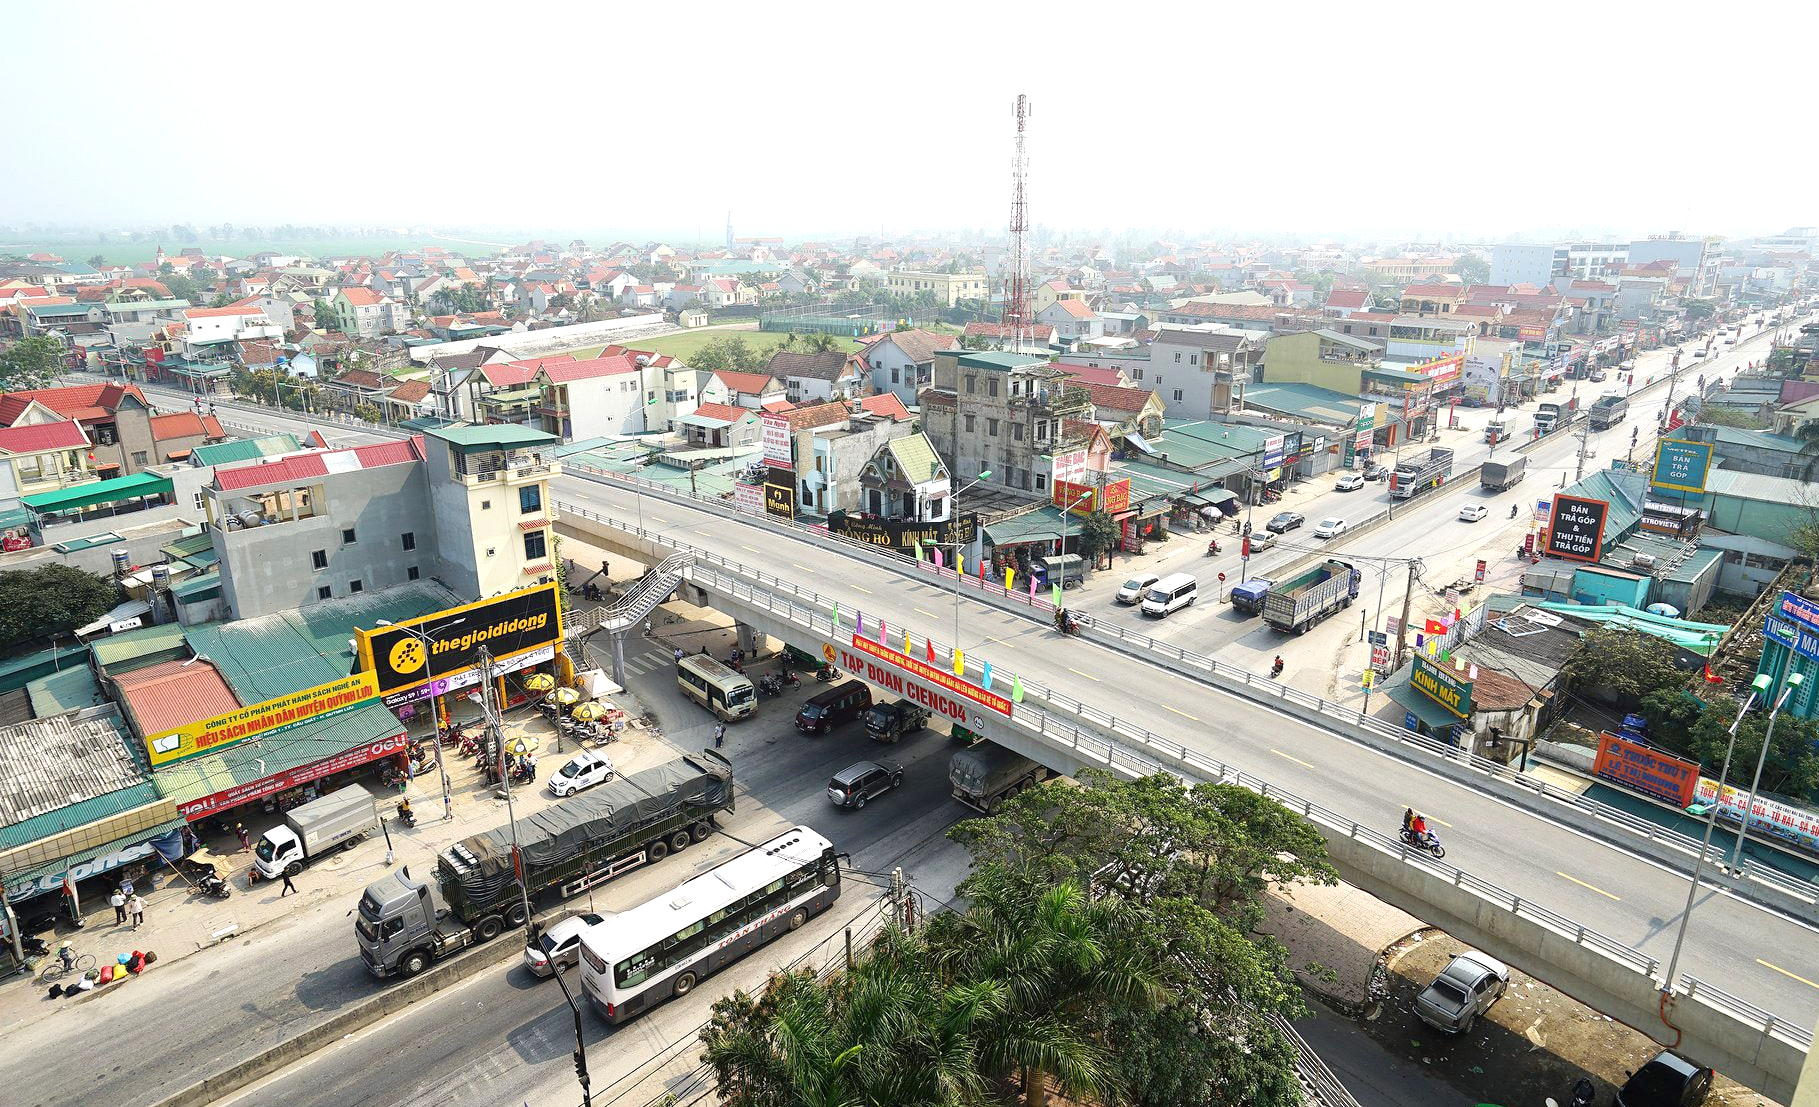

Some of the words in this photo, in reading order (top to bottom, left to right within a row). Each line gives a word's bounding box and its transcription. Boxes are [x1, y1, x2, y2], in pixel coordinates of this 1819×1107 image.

[1672, 454, 1691, 463] BÁN
[1571, 504, 1588, 514] BÁN
[1560, 512, 1576, 522] TRẢ
[1578, 515, 1596, 525] GÓP
[1556, 531, 1574, 541] THU
[1555, 540, 1570, 550] TRẢ
[1572, 544, 1590, 554] GÓP
[432, 612, 547, 655] thegioididong
[1414, 668, 1438, 694] KÍNH
[1439, 684, 1461, 707] MẮT
[205, 718, 227, 730] CÔNG
[229, 716, 237, 724] TY
[351, 678, 361, 687] AN
[386, 695, 407, 705] Galaxy
[906, 682, 966, 723] CIENCO4
[196, 731, 219, 749] HIỆU
[220, 724, 246, 741] SÁCH
[247, 714, 274, 733] NHÂN
[276, 708, 296, 725] DÂN
[297, 700, 326, 715] HUYỆN
[327, 690, 355, 709] QUỲNH
[356, 685, 373, 700] LƯU
[371, 734, 406, 755] deli
